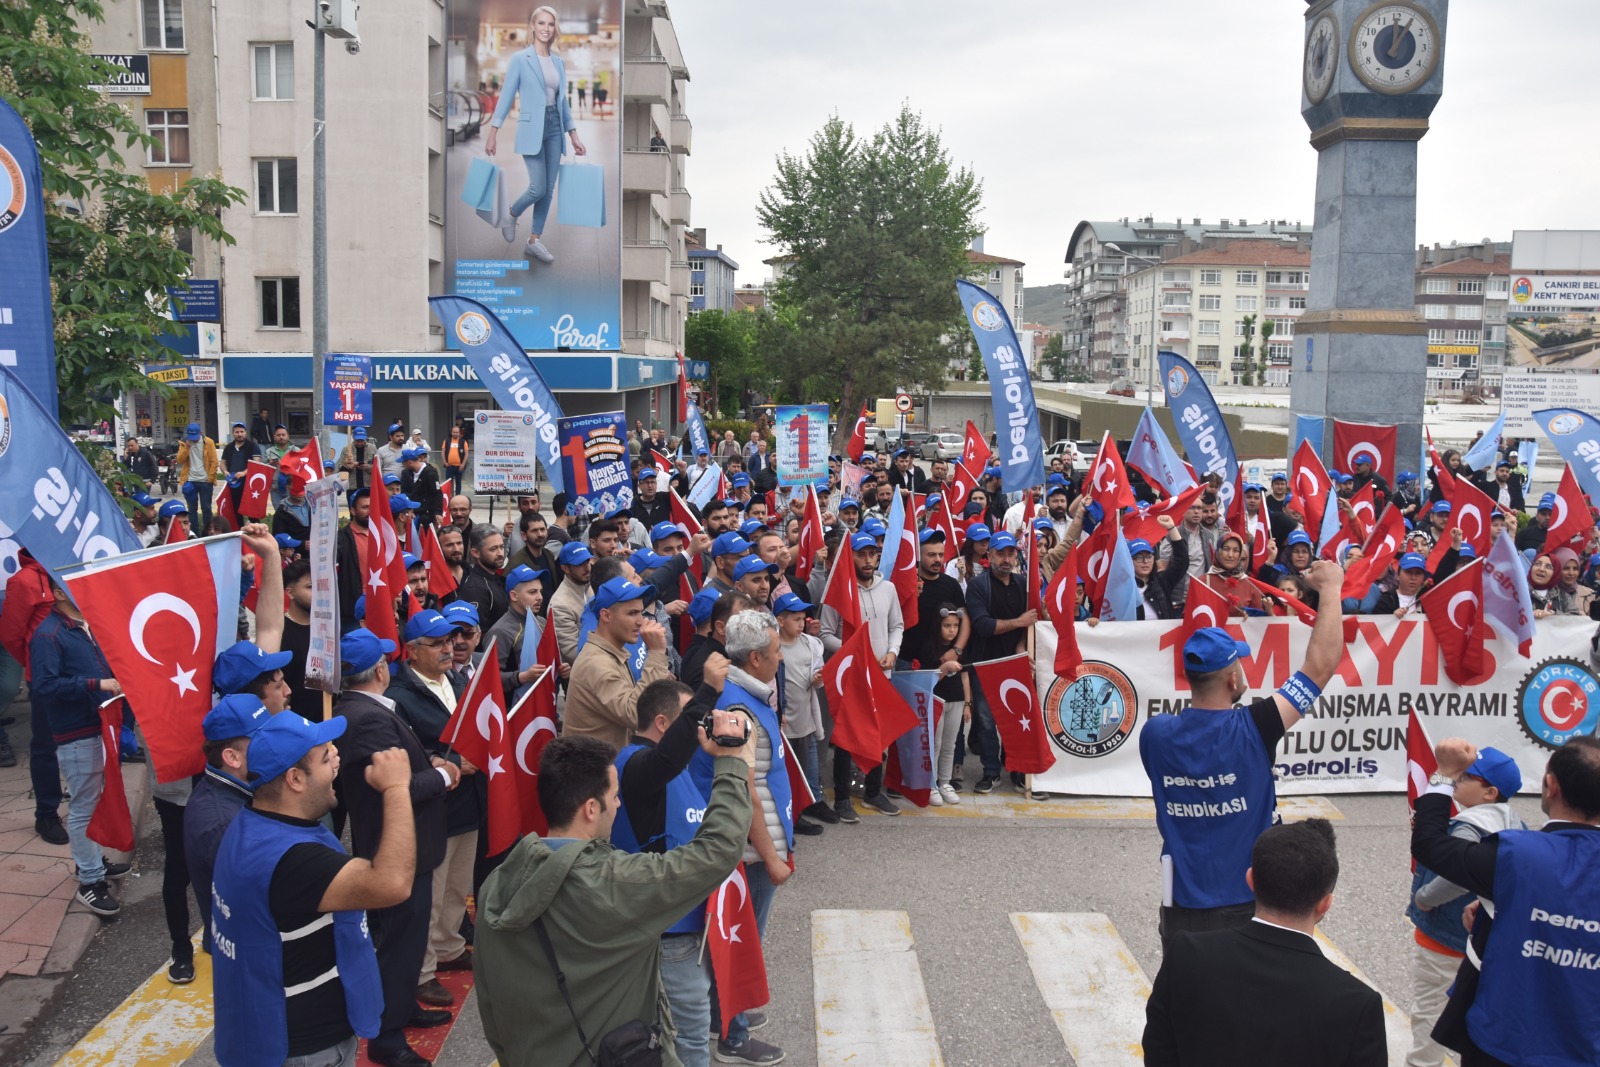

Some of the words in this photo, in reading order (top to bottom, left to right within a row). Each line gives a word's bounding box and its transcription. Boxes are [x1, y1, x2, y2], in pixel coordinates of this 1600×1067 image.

[1377, 17, 1386, 25] 11
[1366, 28, 1376, 36] 10
[1418, 28, 1424, 37] 2
[1362, 41, 1367, 49] 9
[1421, 44, 1427, 52] 3
[1366, 56, 1371, 64] 8
[1376, 68, 1381, 76] 7
[1390, 73, 1395, 81] 6
[1405, 70, 1410, 78] 5
[1544, 281, 1580, 290] ÇANKIRI
[1534, 292, 1557, 300] KENT
[1560, 292, 1600, 300] MEYDANI
[375, 364, 479, 380] HALKBANK
[329, 382, 366, 390] YAŞASIN
[343, 389, 352, 411] 1
[173, 405, 185, 414] 10
[334, 412, 363, 421] Mayıs
[572, 417, 612, 428] petrol-iş
[790, 414, 809, 468] 1
[500, 449, 524, 457] DİYORUZ
[561, 436, 589, 495] 1
[592, 470, 629, 492] Alanlara
[1302, 692, 1392, 724] ANIŞMA
[1398, 692, 1507, 717] BAYRAMI
[915, 692, 932, 772] petrol-iş
[1060, 735, 1097, 755] PETROL-İŞ
[1102, 734, 1122, 751] 1950
[1283, 730, 1326, 755] TLU
[1330, 727, 1409, 752] OLSUN
[1273, 757, 1378, 781] petrol-iş
[1163, 773, 1237, 788] petrol-iş
[1166, 797, 1248, 818] SENDİKASI
[1530, 907, 1600, 933] petro
[1521, 939, 1600, 971] SENDİKA
